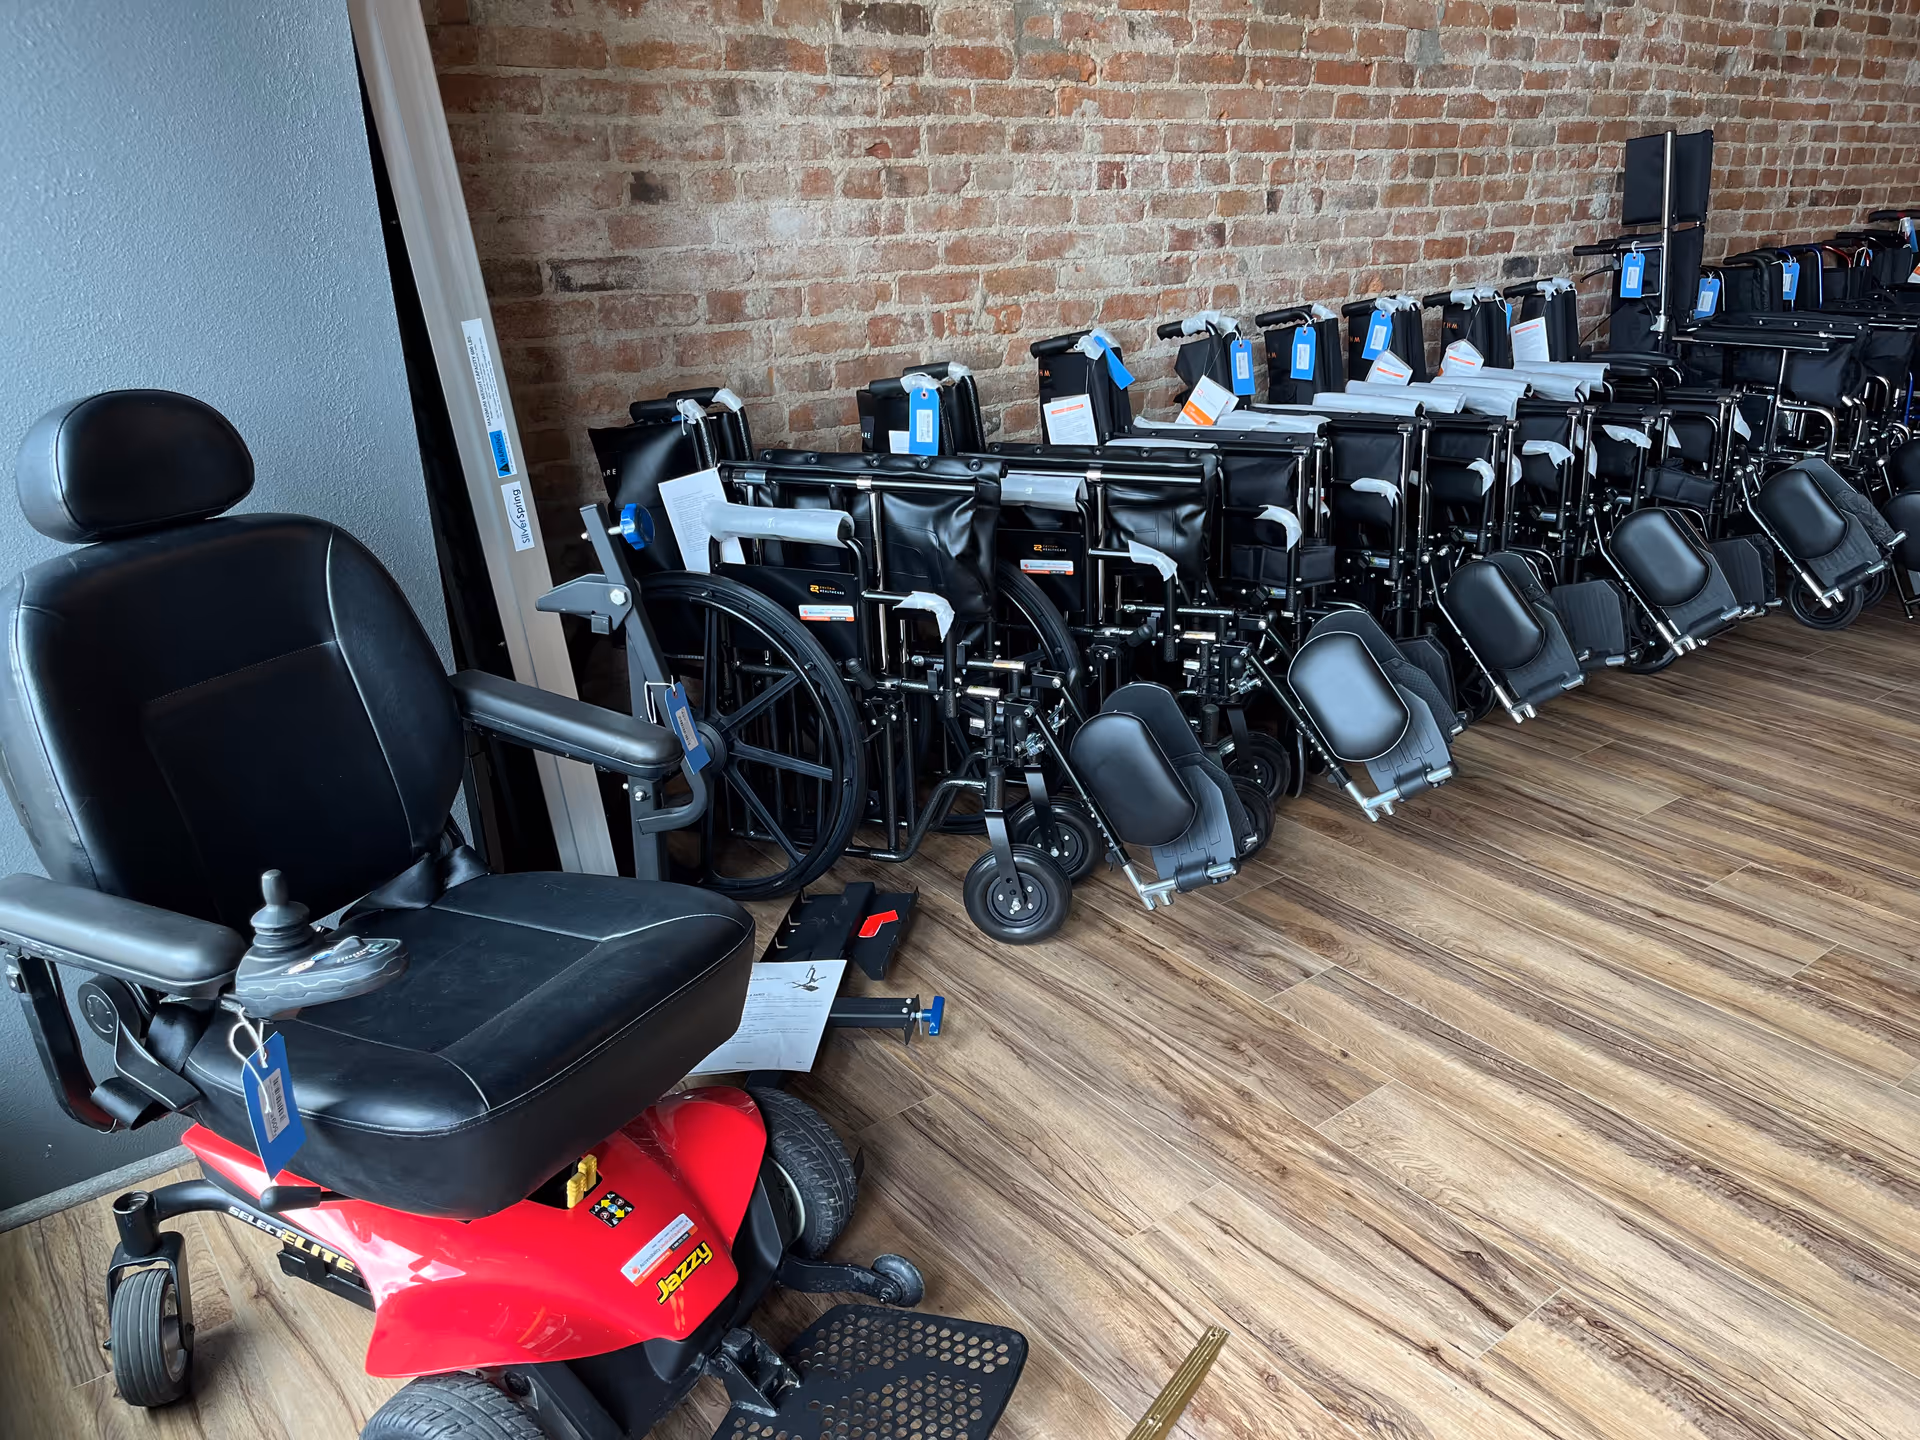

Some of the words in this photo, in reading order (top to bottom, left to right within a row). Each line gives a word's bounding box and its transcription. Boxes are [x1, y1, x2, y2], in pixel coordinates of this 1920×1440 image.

[471, 356, 481, 381] CAPACITY
[477, 381, 486, 400] WEIGHT
[483, 400, 492, 426] MAXIMUM
[494, 433, 507, 464] WARNING
[512, 488, 530, 544] SilverSpring
[228, 1205, 286, 1240] SELECT
[281, 1228, 355, 1273] ELITE
[657, 1241, 713, 1305] Jazzy
